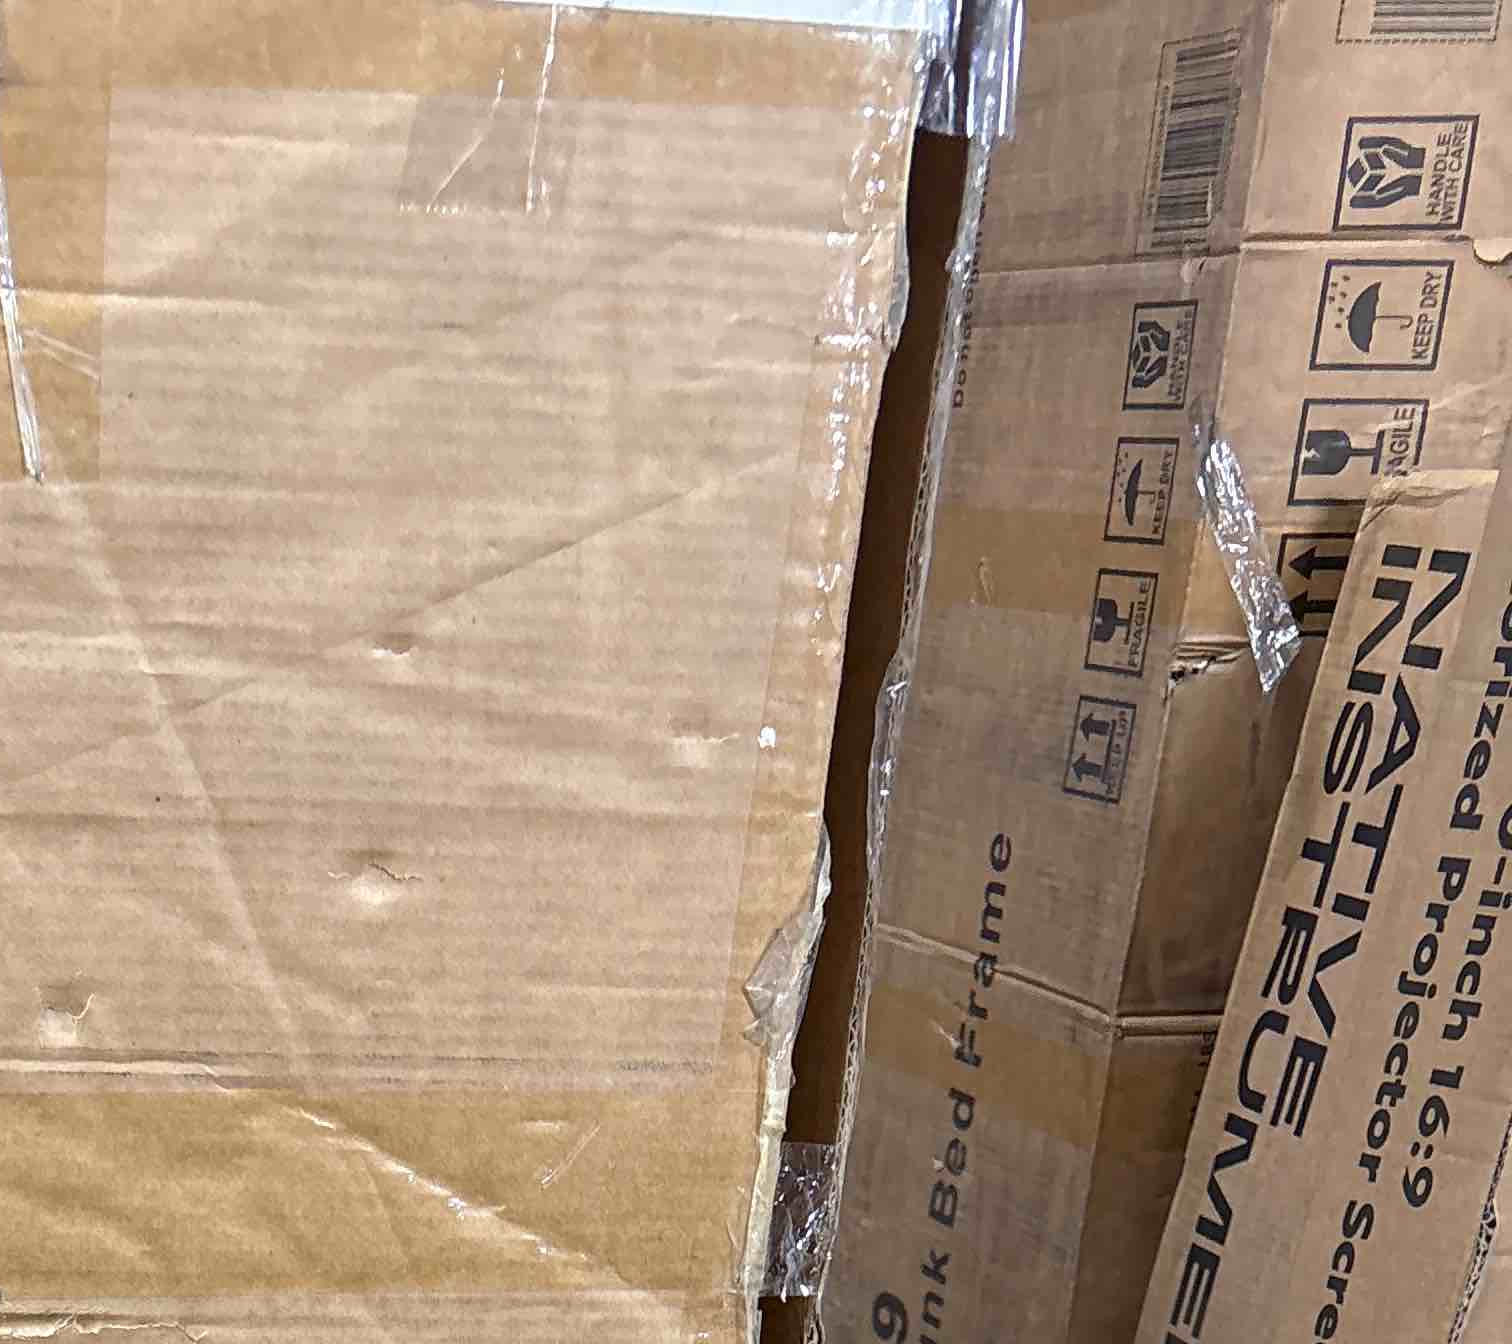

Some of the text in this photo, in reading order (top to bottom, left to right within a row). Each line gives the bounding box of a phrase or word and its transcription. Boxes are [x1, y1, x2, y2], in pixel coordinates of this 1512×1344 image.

[1426, 132, 1451, 216] HANDLE
[1440, 121, 1468, 222] WITH CARE
[1412, 271, 1443, 360] KEEP DRY
[1385, 407, 1416, 478] AGILE
[1127, 579, 1151, 668] FRAGILE
[1269, 548, 1472, 1137] NATIVE
[928, 1086, 976, 1229] Bed
[952, 832, 1012, 1068] Frame
[1358, 856, 1472, 1184] Projector
[1402, 1064, 1466, 1207] 16:9
